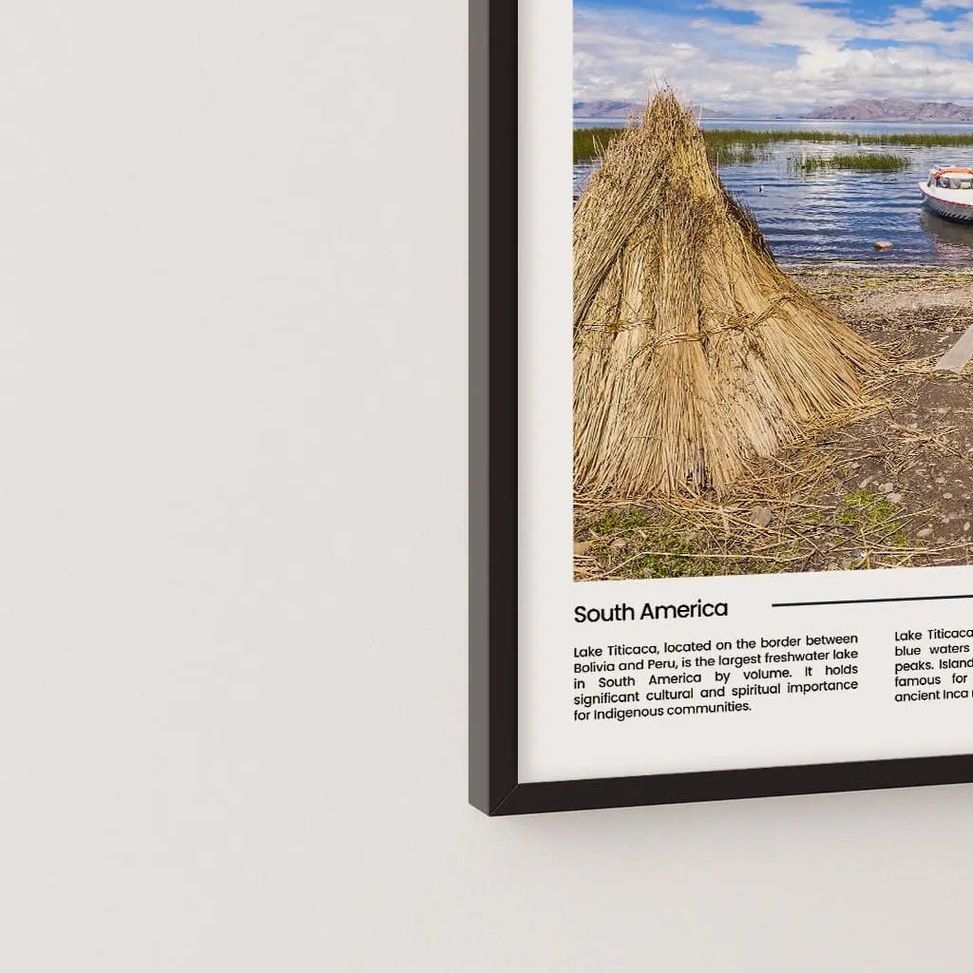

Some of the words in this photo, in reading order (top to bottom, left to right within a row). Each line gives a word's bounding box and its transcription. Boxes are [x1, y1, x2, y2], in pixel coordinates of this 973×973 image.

[574, 603, 635, 623] South
[640, 599, 728, 620] America
[574, 646, 603, 658] Lake
[607, 644, 660, 656] Titicaca,
[664, 640, 712, 653] located
[715, 642, 732, 651] on
[736, 638, 757, 650] the
[761, 636, 801, 648] border
[806, 635, 858, 646] between
[895, 630, 923, 642] Lake
[574, 661, 615, 673] Bolivia
[618, 659, 644, 671] and
[648, 659, 678, 670] Peru,
[682, 657, 692, 668] is
[695, 656, 716, 667] the
[718, 654, 761, 669] largest
[764, 651, 830, 663] freshwater
[833, 648, 858, 660] lake
[895, 646, 921, 656] blue
[929, 644, 970, 654] waters
[574, 678, 585, 689] in
[598, 676, 635, 688] South
[648, 672, 702, 685] America
[715, 671, 731, 685] by
[743, 669, 792, 680] volume.
[805, 666, 813, 677] It
[825, 664, 858, 676] holds
[895, 660, 934, 675] peaks.
[895, 676, 941, 687] famous
[952, 673, 968, 684] for
[573, 691, 640, 708] significant
[646, 687, 694, 701] cultural
[700, 686, 725, 698] and
[731, 683, 781, 699] spiritual
[787, 681, 859, 695] importance
[894, 690, 941, 702] ancient
[943, 689, 969, 699] Inca
[574, 710, 591, 721] for
[594, 707, 664, 722] Indigenous
[667, 701, 752, 716] communities.
